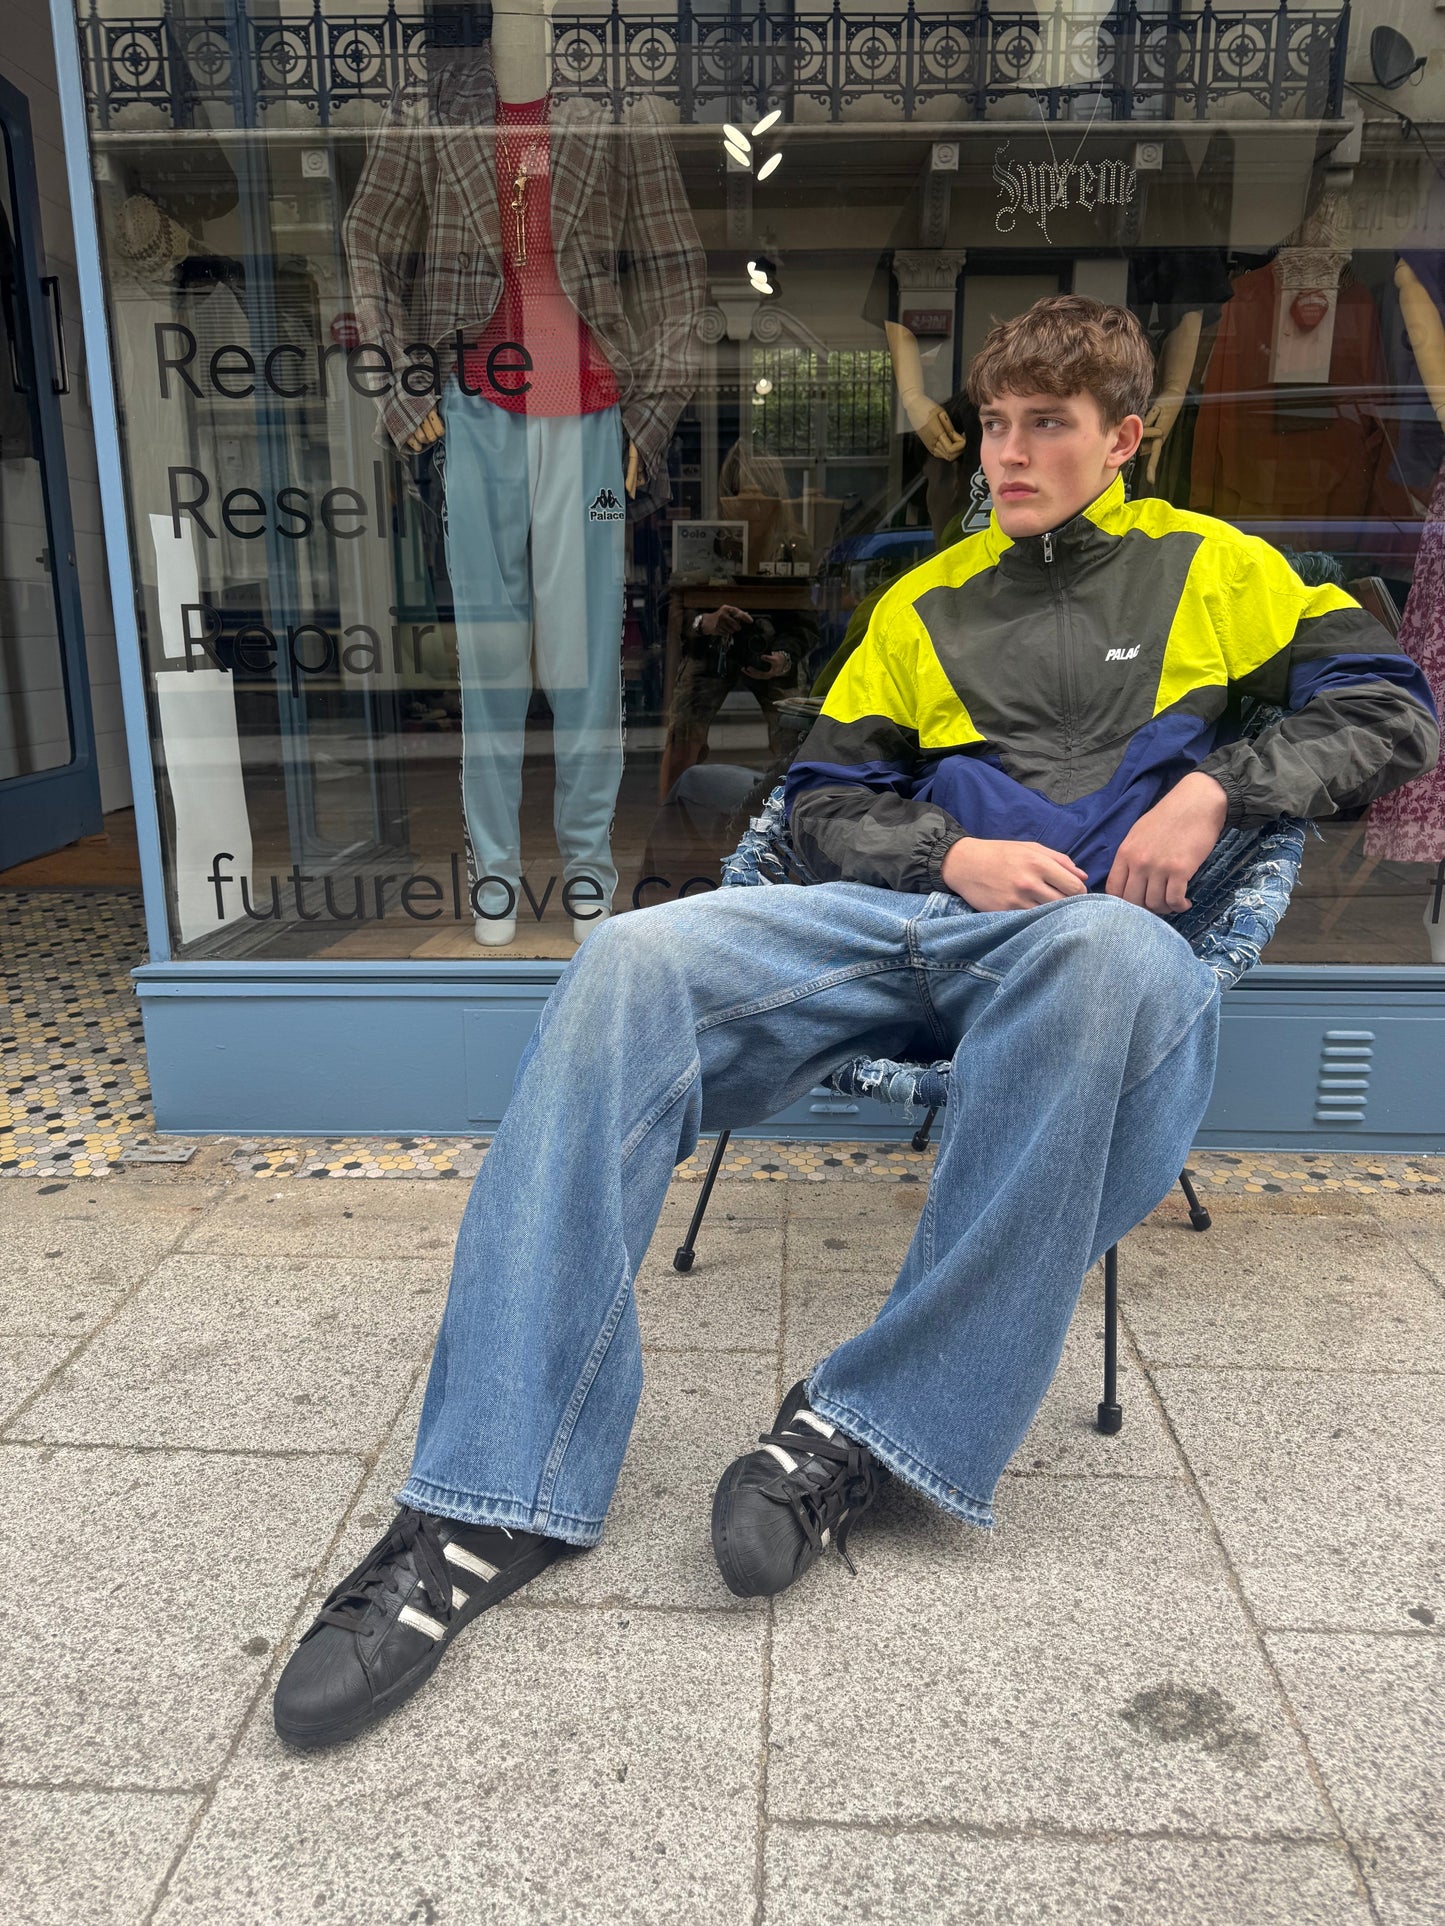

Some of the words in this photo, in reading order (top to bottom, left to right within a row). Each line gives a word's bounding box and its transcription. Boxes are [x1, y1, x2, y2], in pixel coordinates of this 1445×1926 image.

[153, 322, 534, 399] Recreate
[167, 460, 408, 540] Resell
[589, 510, 625, 521] Palace
[180, 603, 436, 698] Repair
[1104, 643, 1141, 662] PALAC
